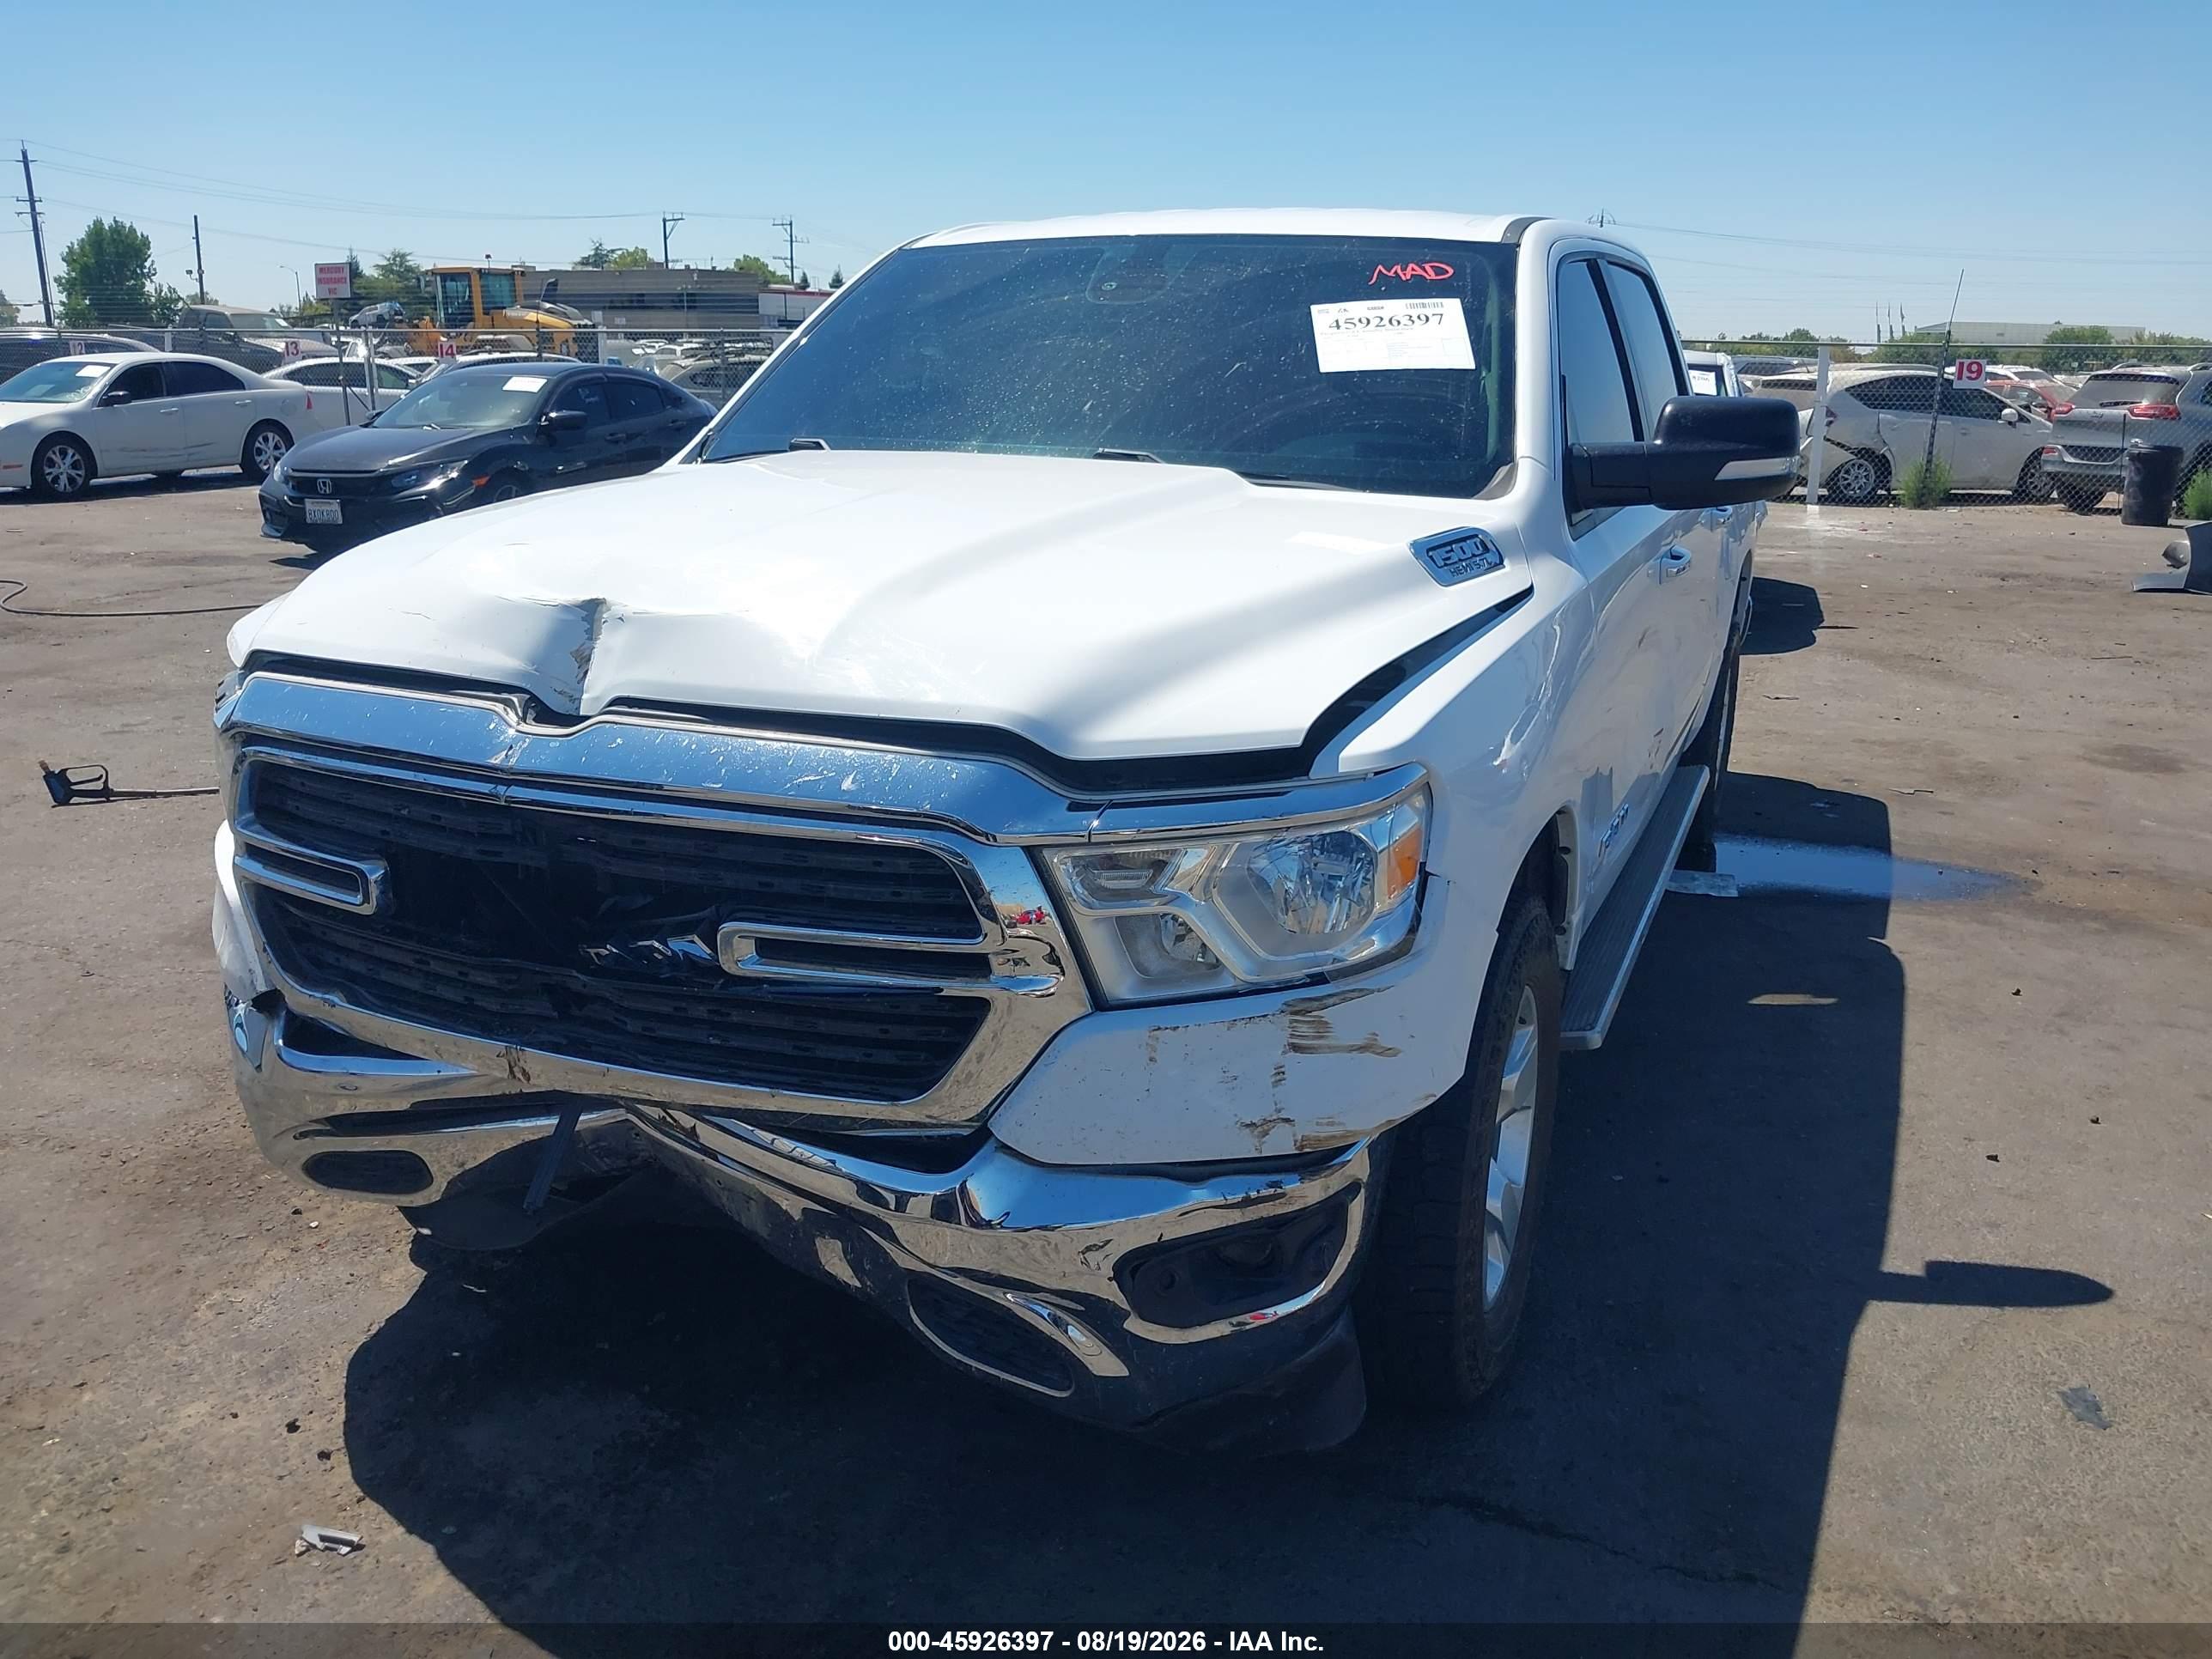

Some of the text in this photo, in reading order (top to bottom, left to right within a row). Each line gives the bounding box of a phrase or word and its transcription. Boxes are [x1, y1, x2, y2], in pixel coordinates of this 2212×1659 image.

[318, 276, 347, 285] INSURANCE
[1368, 262, 1455, 285] MAD
[1328, 313, 1444, 330] 45926397
[285, 341, 300, 357] 13
[439, 343, 455, 358] 14
[1956, 361, 1983, 381] 19
[1427, 535, 1487, 568] 1500
